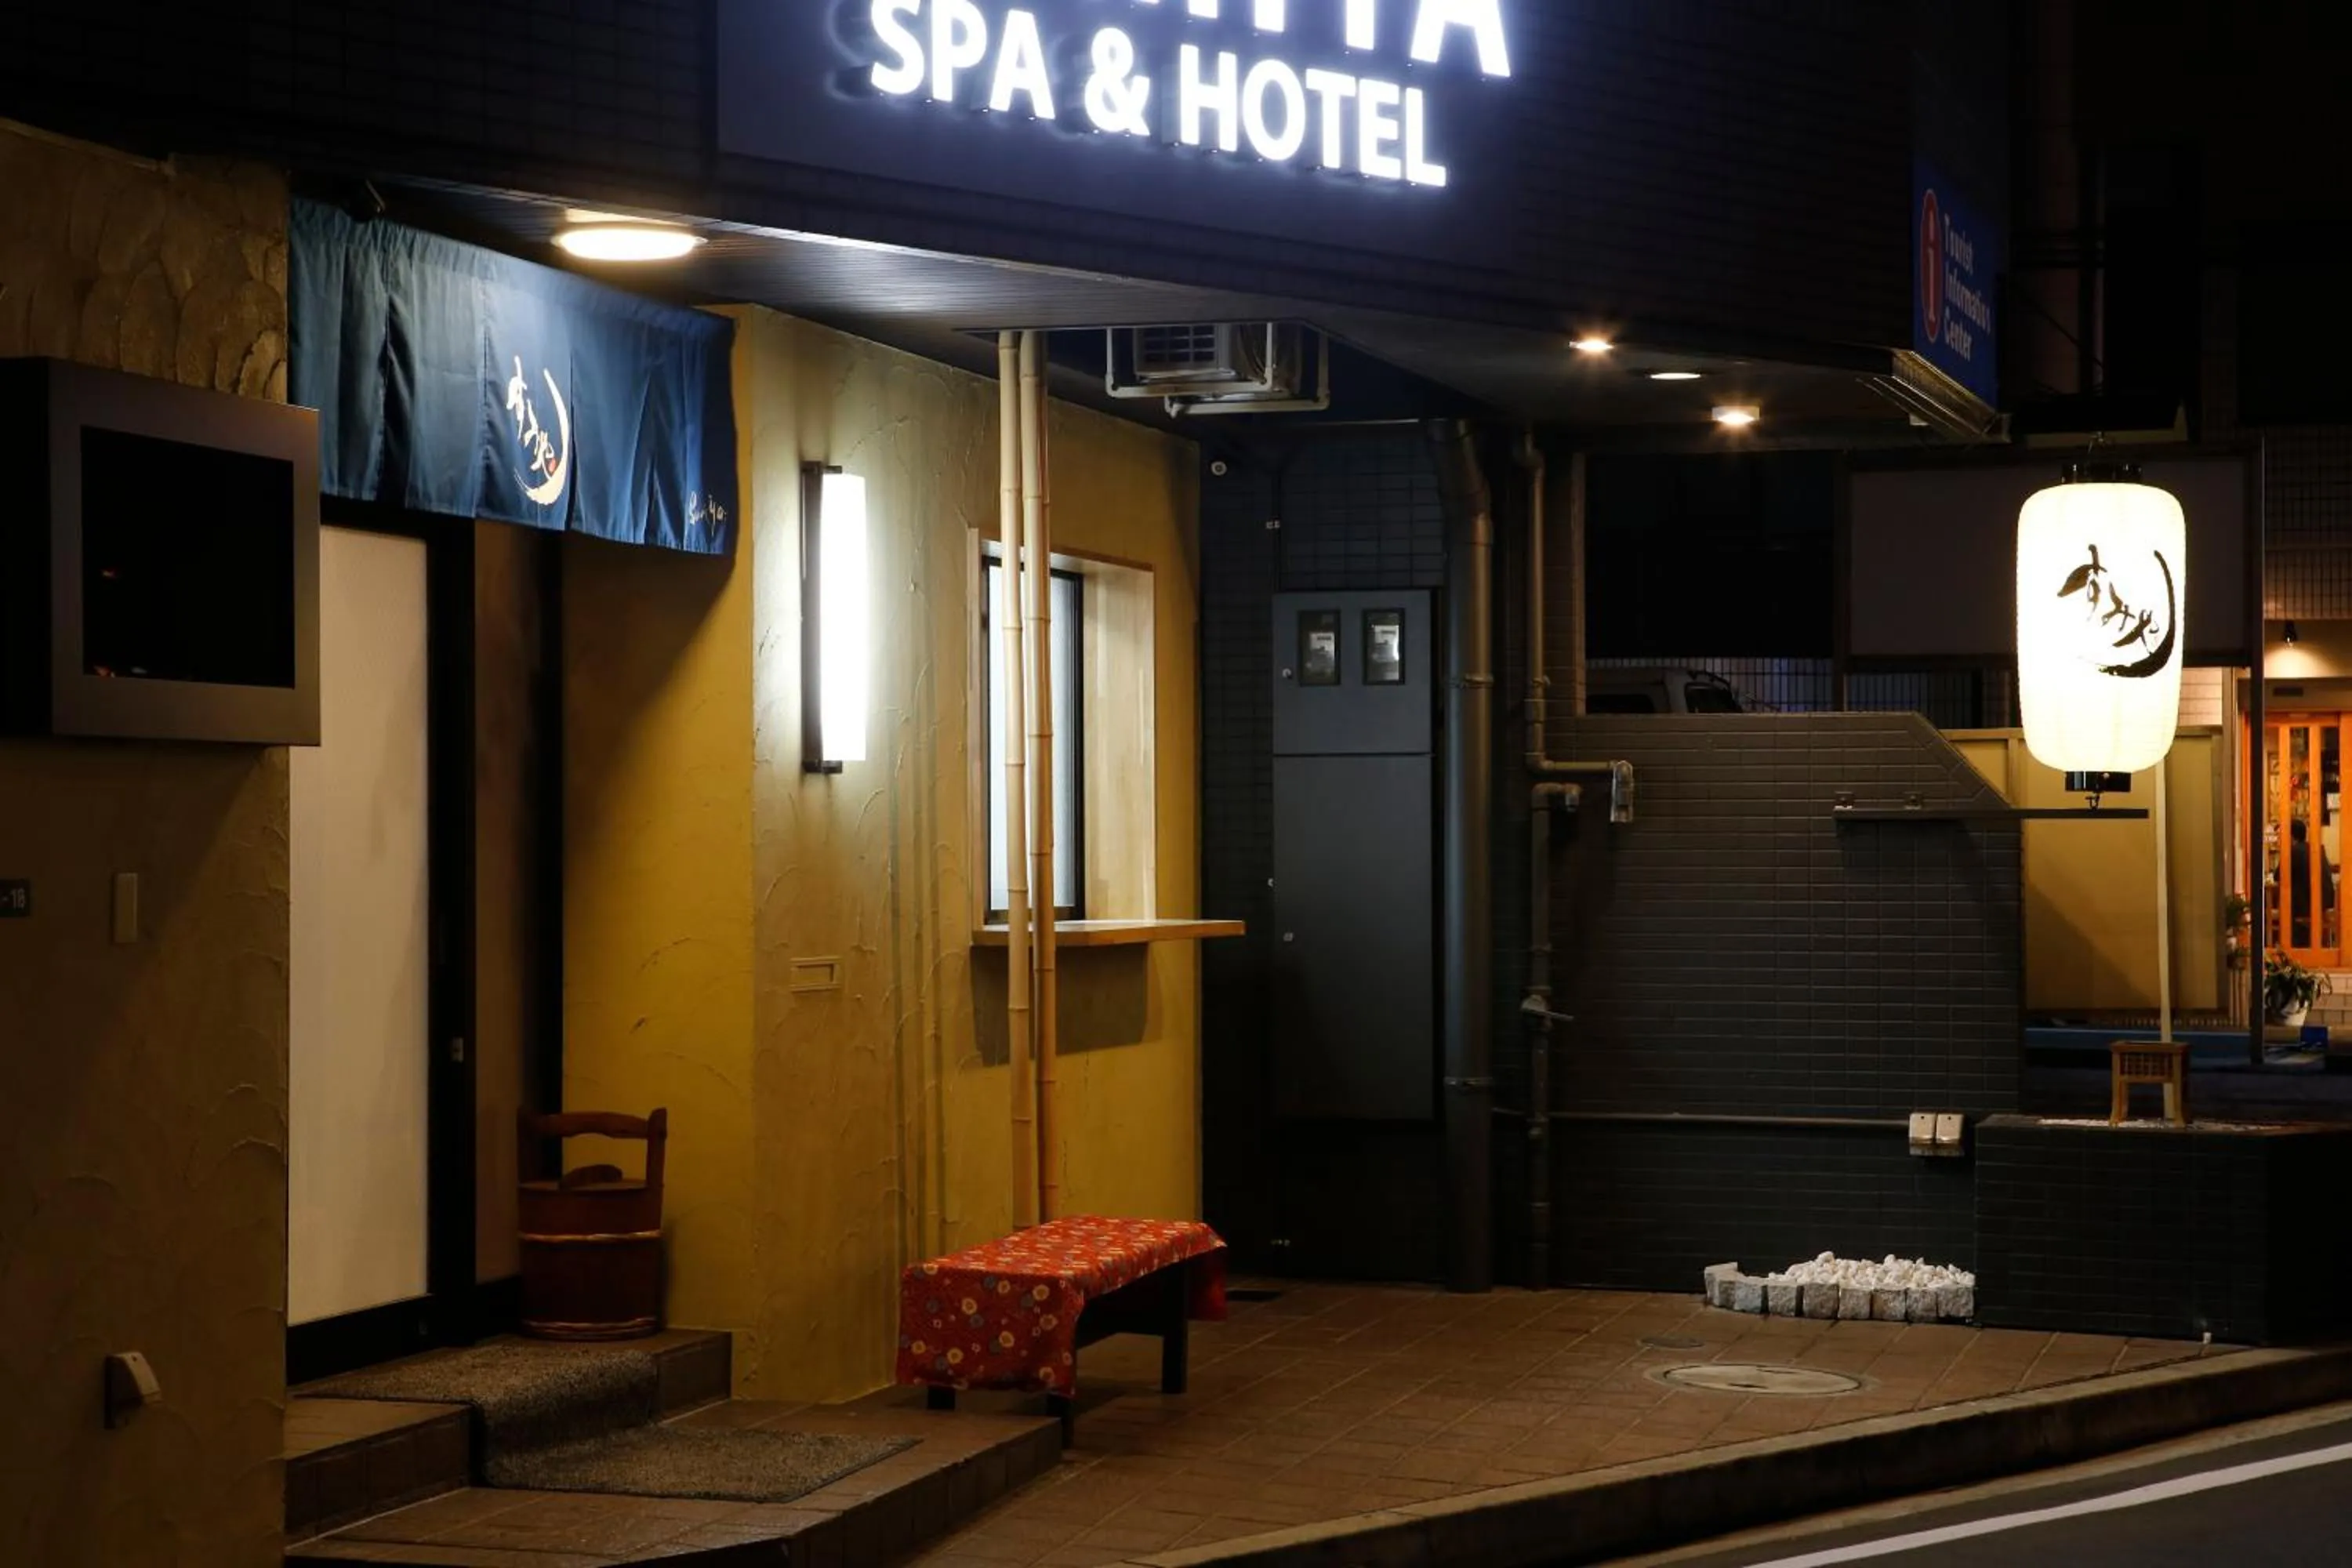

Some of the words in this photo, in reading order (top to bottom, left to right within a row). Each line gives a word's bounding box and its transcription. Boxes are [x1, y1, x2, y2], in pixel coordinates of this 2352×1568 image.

[871, 0, 1055, 119] SPA
[1084, 27, 1150, 136] &
[1180, 45, 1446, 187] HOTEL
[1944, 212, 1973, 276] Tourist
[1944, 260, 1991, 335] Information
[1944, 305, 1973, 361] Center
